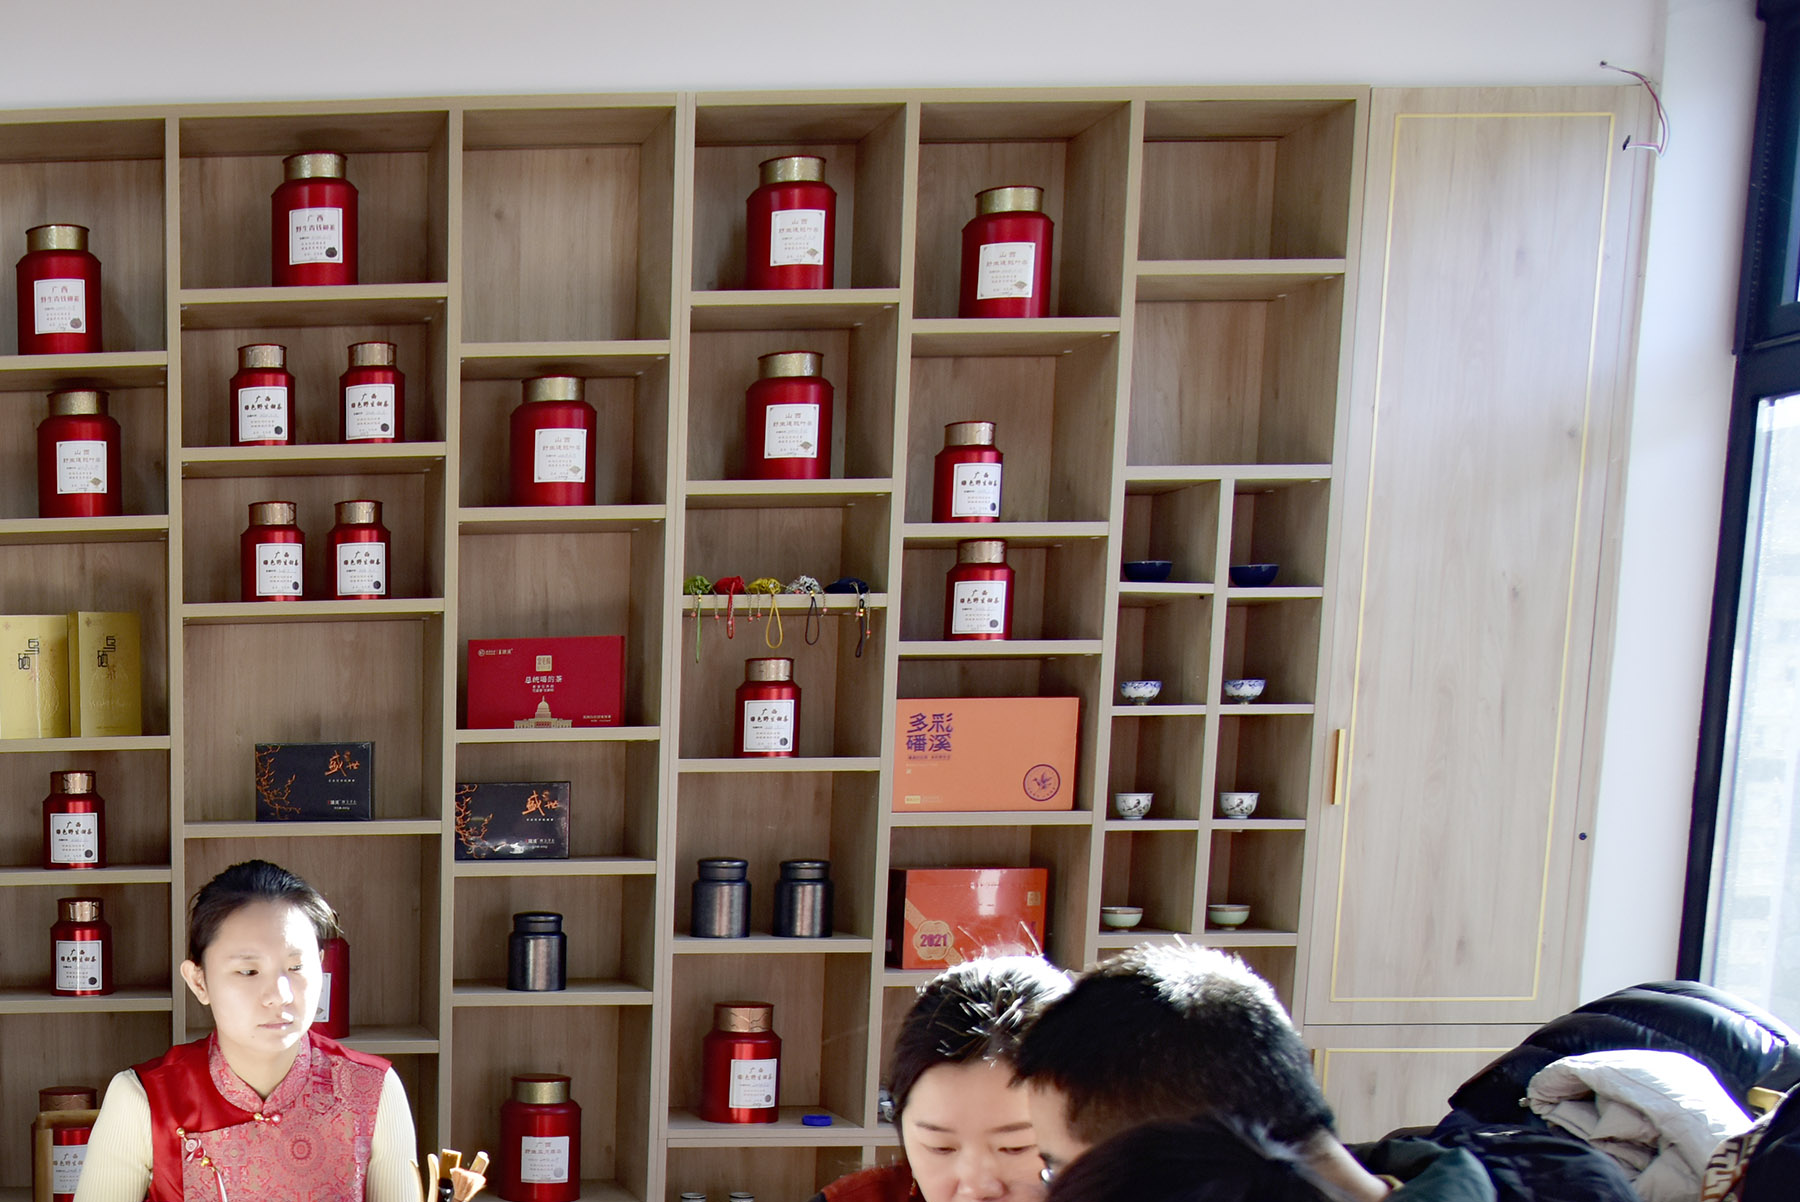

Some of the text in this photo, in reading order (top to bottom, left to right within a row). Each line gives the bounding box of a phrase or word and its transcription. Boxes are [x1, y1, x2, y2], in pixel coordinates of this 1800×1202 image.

[906, 712, 953, 733] 多彩
[906, 733, 952, 752] 磻溪
[920, 934, 948, 947] 2021
